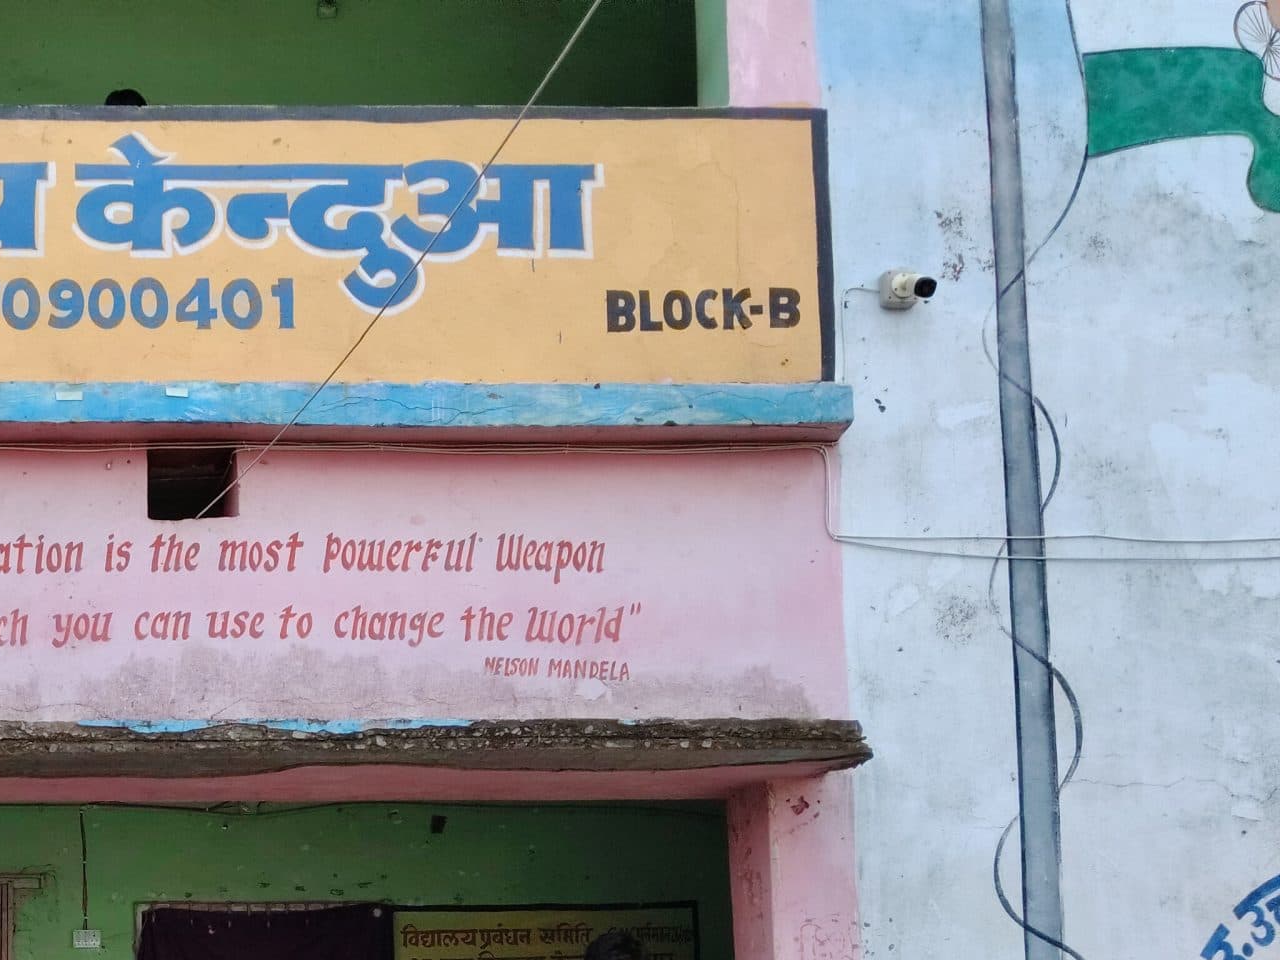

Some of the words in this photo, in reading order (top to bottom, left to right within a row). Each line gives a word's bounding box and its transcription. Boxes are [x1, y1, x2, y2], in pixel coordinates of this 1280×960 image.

[73, 133, 599, 312] केन्दुआ
[606, 287, 801, 333] BLOCK-B
[104, 533, 133, 573] is
[149, 533, 200, 573] the
[217, 532, 304, 573] most
[52, 609, 114, 648] you
[133, 609, 192, 641] can
[206, 608, 265, 640] use
[279, 604, 313, 640] to
[334, 605, 446, 647] change
[460, 606, 514, 642] the
[484, 656, 540, 678] NELSON
[547, 657, 631, 682] MANDELA
[401, 924, 477, 948] विद्यालय
